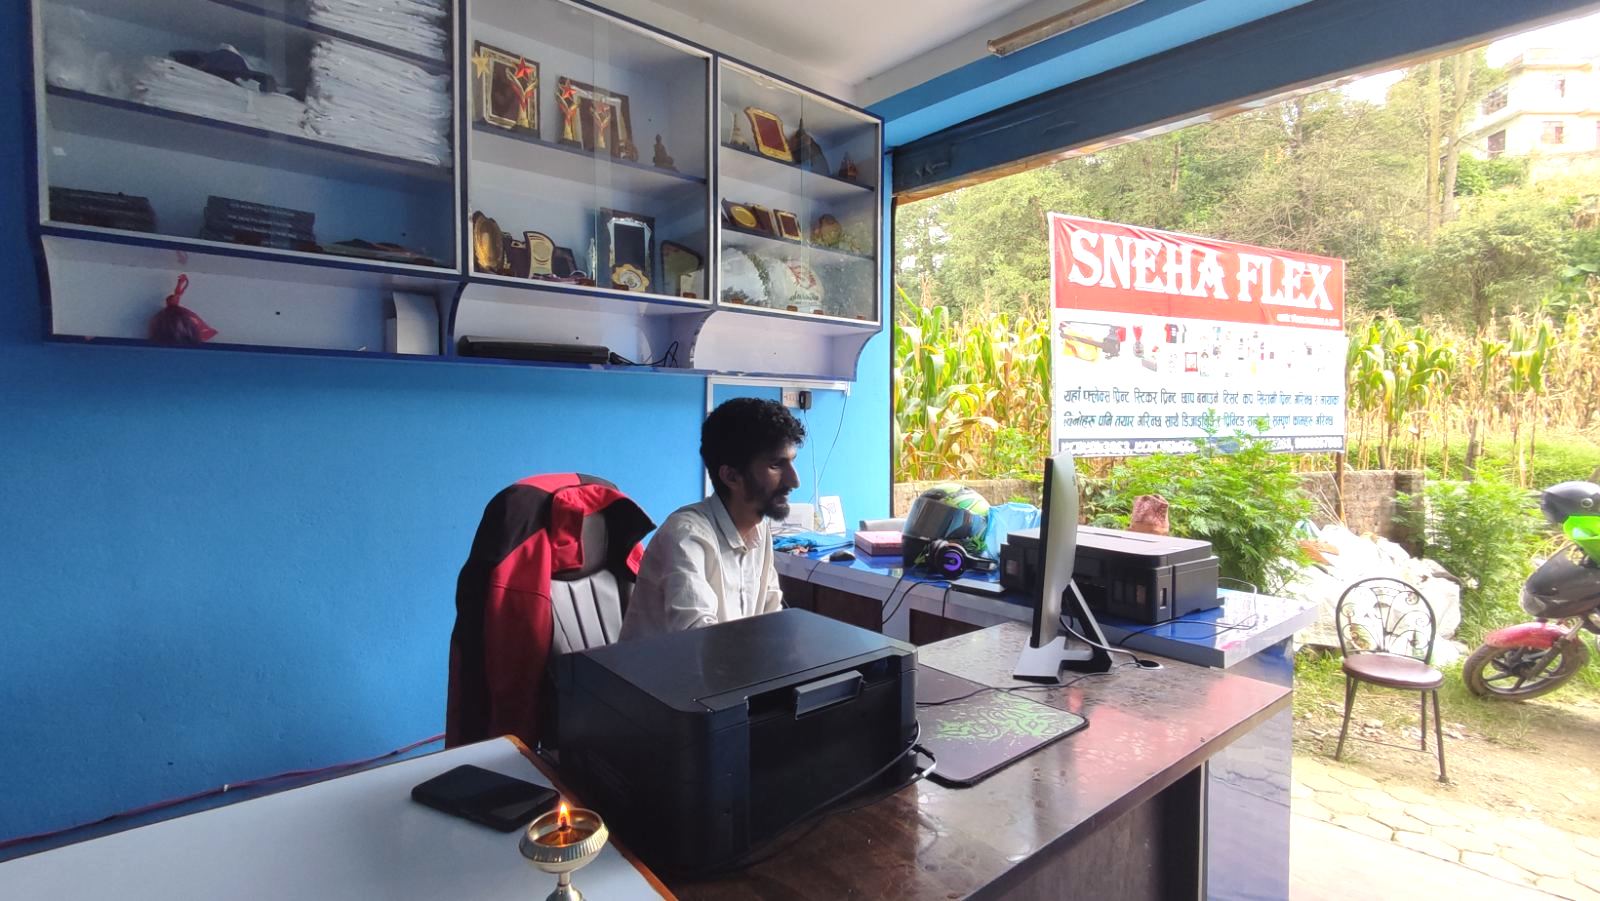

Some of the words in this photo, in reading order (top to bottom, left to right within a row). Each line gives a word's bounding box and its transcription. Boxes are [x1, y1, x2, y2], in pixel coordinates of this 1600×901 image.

[1067, 228, 1229, 300] SNEHA
[1236, 252, 1334, 311] FLEX
[1133, 387, 1158, 404] स्टिकर
[1098, 411, 1113, 427] पनि
[1115, 415, 1135, 427] तयार
